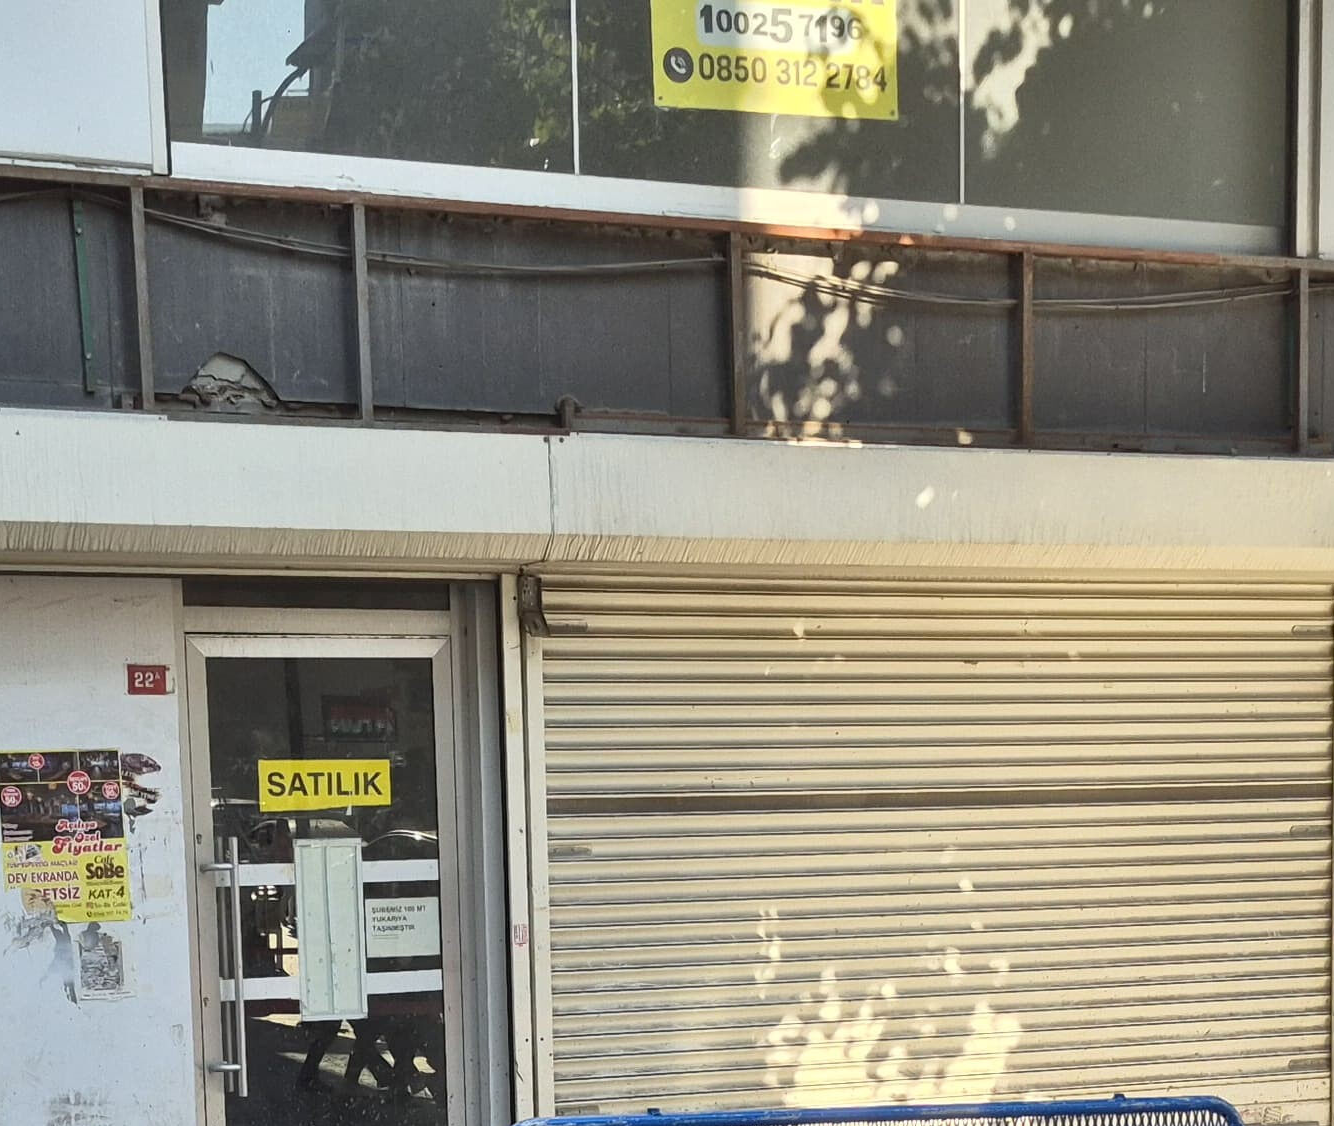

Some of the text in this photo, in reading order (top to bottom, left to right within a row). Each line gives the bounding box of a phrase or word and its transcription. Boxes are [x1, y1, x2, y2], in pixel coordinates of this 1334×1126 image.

[699, 53, 887, 92] 0850 312 2784
[267, 772, 384, 797] SATILIK
[7, 871, 79, 884] DEV EKRANDA
